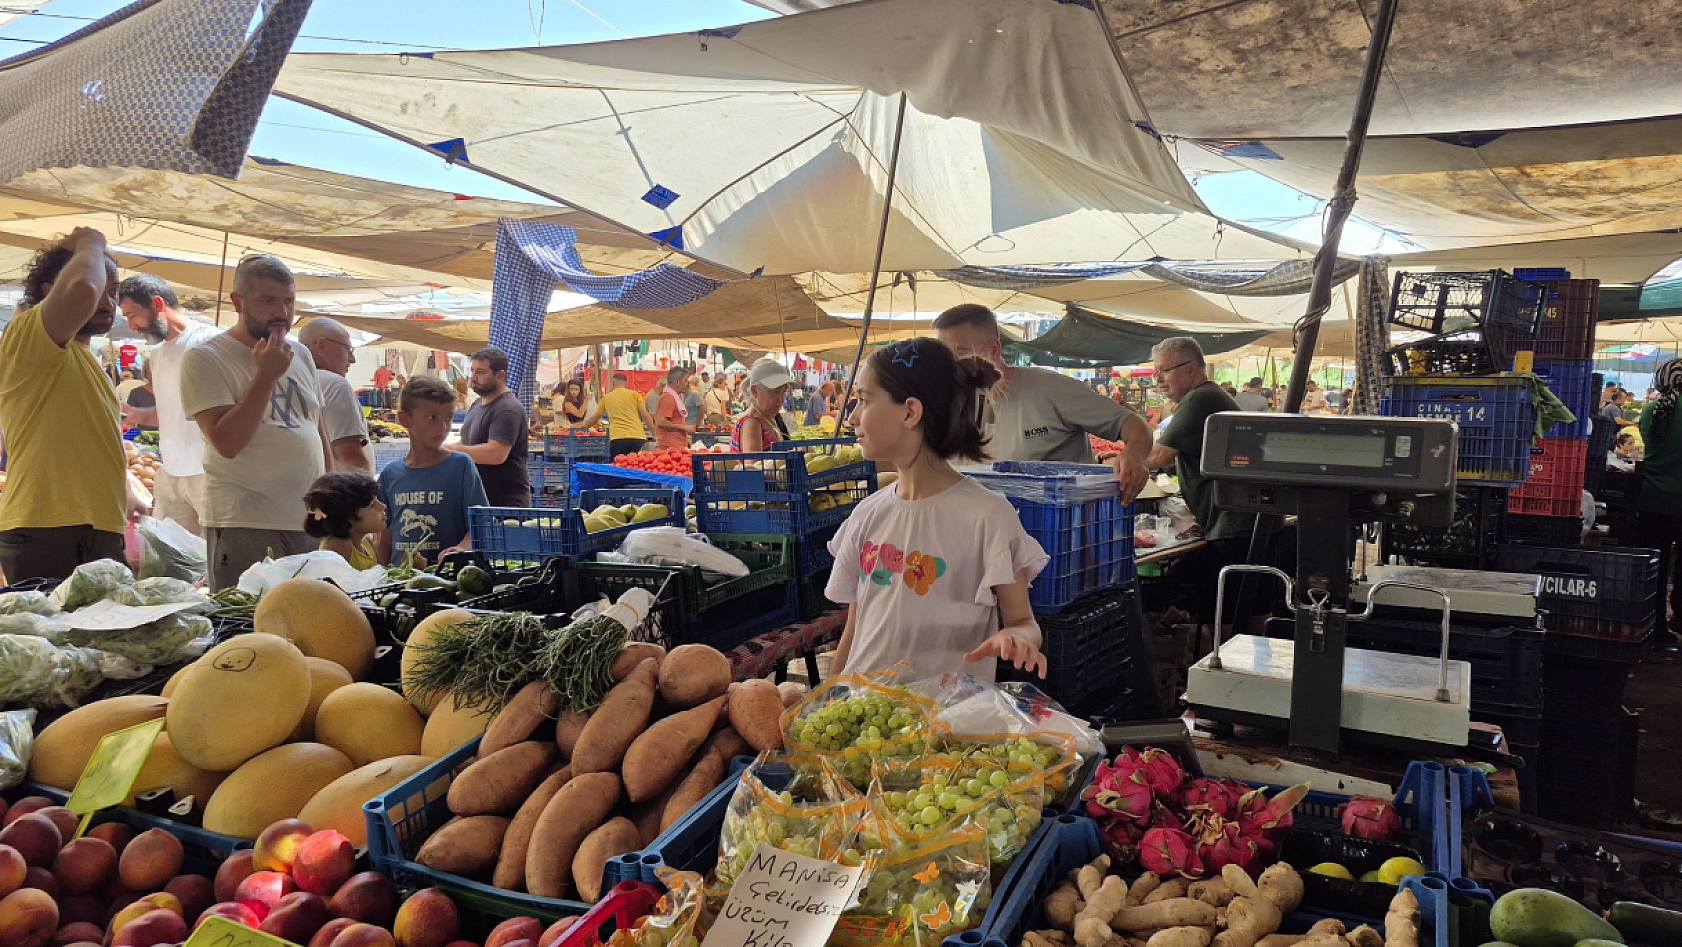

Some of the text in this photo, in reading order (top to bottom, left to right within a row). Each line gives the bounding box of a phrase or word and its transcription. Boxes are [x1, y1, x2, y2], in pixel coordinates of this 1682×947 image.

[1467, 406, 1486, 421] 14
[394, 490, 444, 506] HOUSE OF
